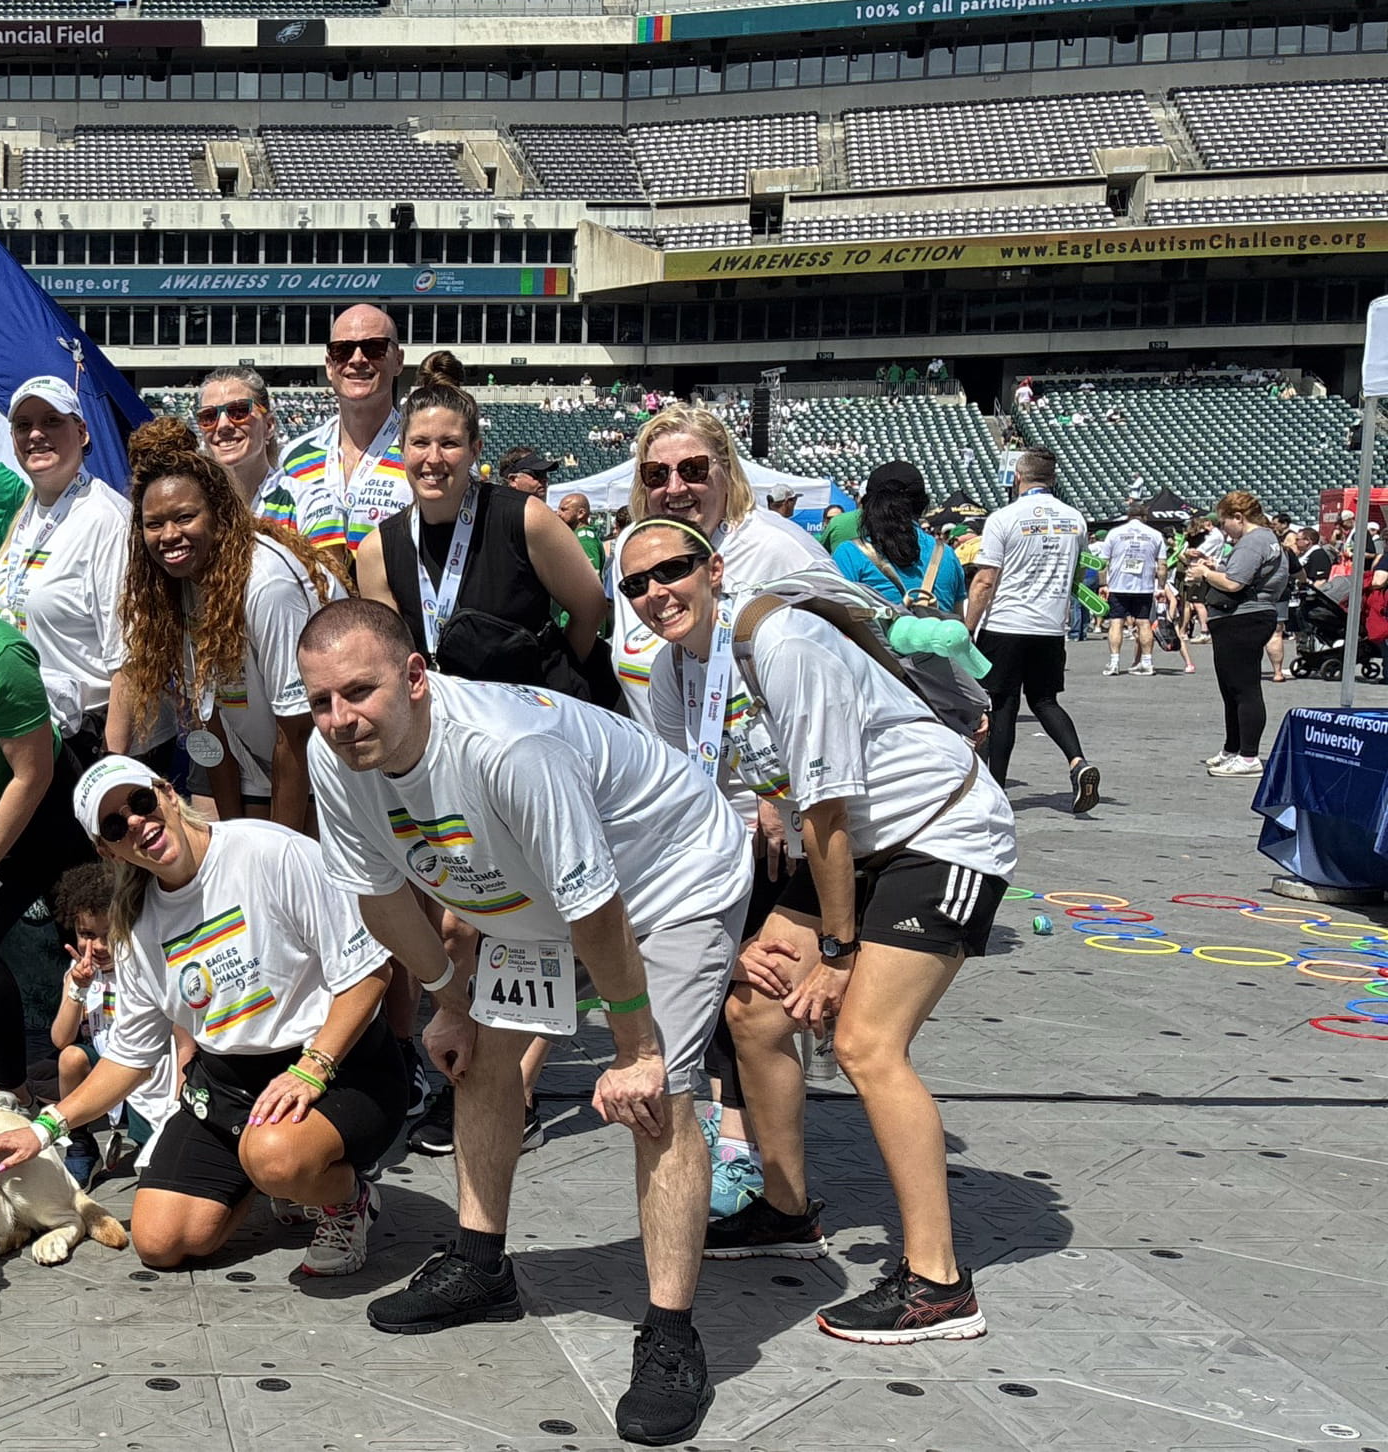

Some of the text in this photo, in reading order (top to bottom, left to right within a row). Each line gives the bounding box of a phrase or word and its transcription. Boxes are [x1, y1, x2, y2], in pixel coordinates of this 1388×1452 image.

[856, 3, 900, 20] 100%
[907, 2, 925, 15] of
[932, 0, 953, 13] all
[56, 26, 104, 45] Field
[708, 232, 1368, 272] AWARENESS TO ACTION www.EaglesAutismChallenge.org
[160, 274, 268, 290] AWARENESS
[277, 274, 302, 289] TO
[308, 273, 382, 289] ACTION
[360, 487, 393, 497] UTISM
[358, 496, 409, 511] HALLENG
[1152, 511, 1190, 520] nrg
[806, 522, 823, 532] Ind
[1305, 725, 1364, 755] University
[80, 772, 104, 809] EAGLES
[893, 924, 925, 934] adidas
[205, 947, 238, 968] EAGLES
[212, 958, 242, 977] AUTISM
[490, 977, 556, 1009] 4411
